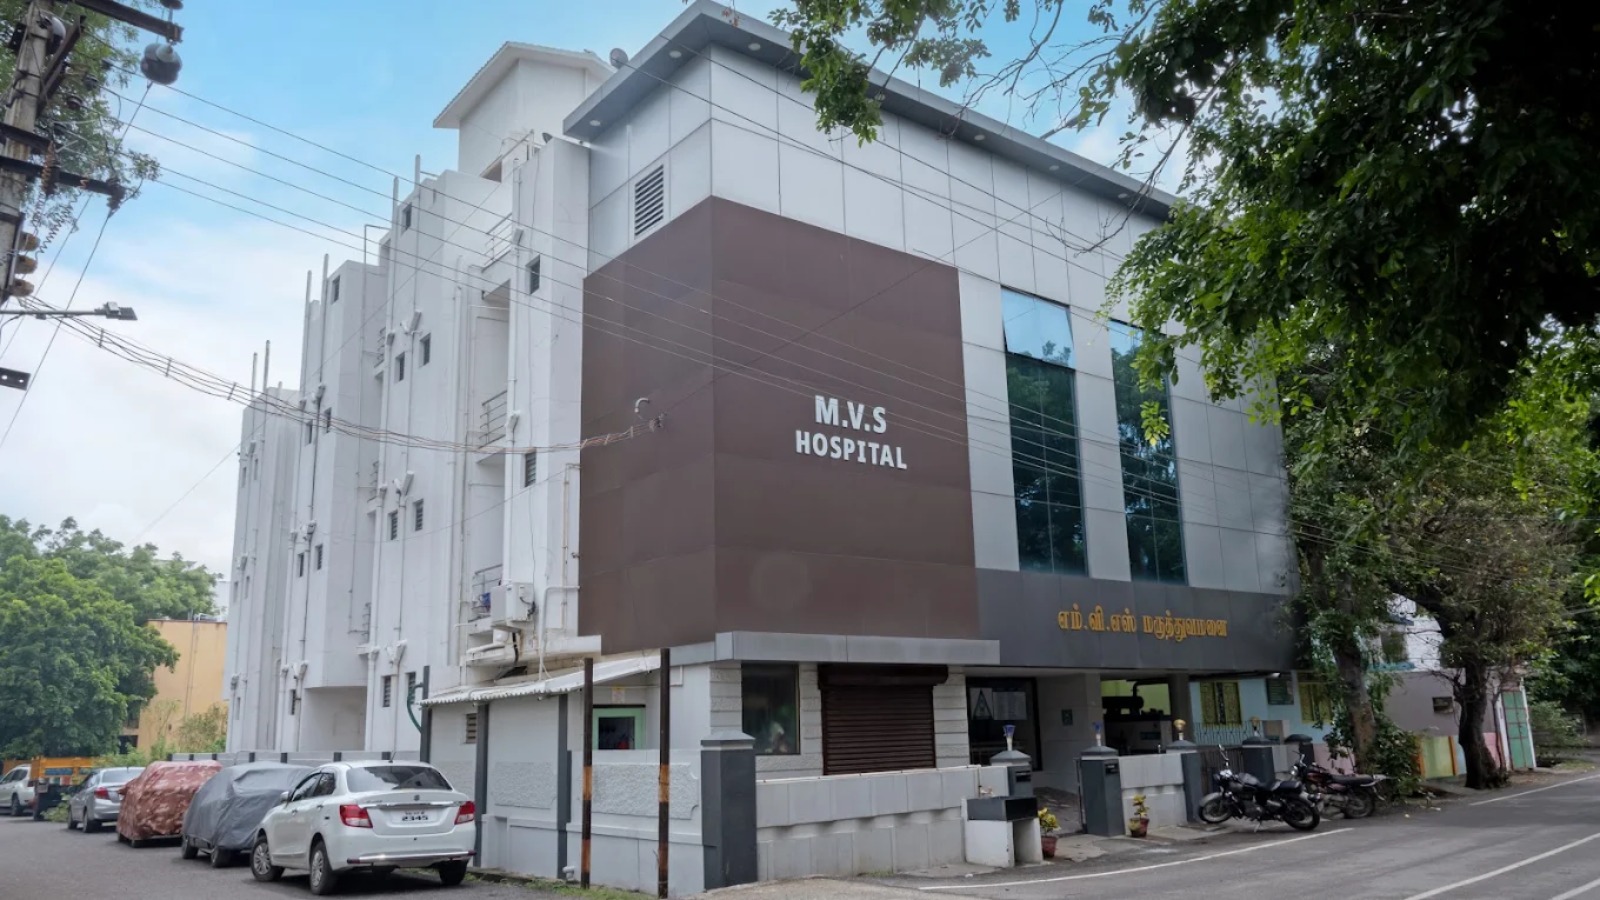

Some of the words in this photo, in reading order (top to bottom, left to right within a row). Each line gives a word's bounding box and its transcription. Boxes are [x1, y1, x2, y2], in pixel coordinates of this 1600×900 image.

[815, 395, 887, 434] M.V.S
[796, 430, 907, 469] HOSPITAL
[1058, 603, 1136, 632] எம்.வி.எஸ்
[1143, 609, 1227, 641] மருத்துவமனை
